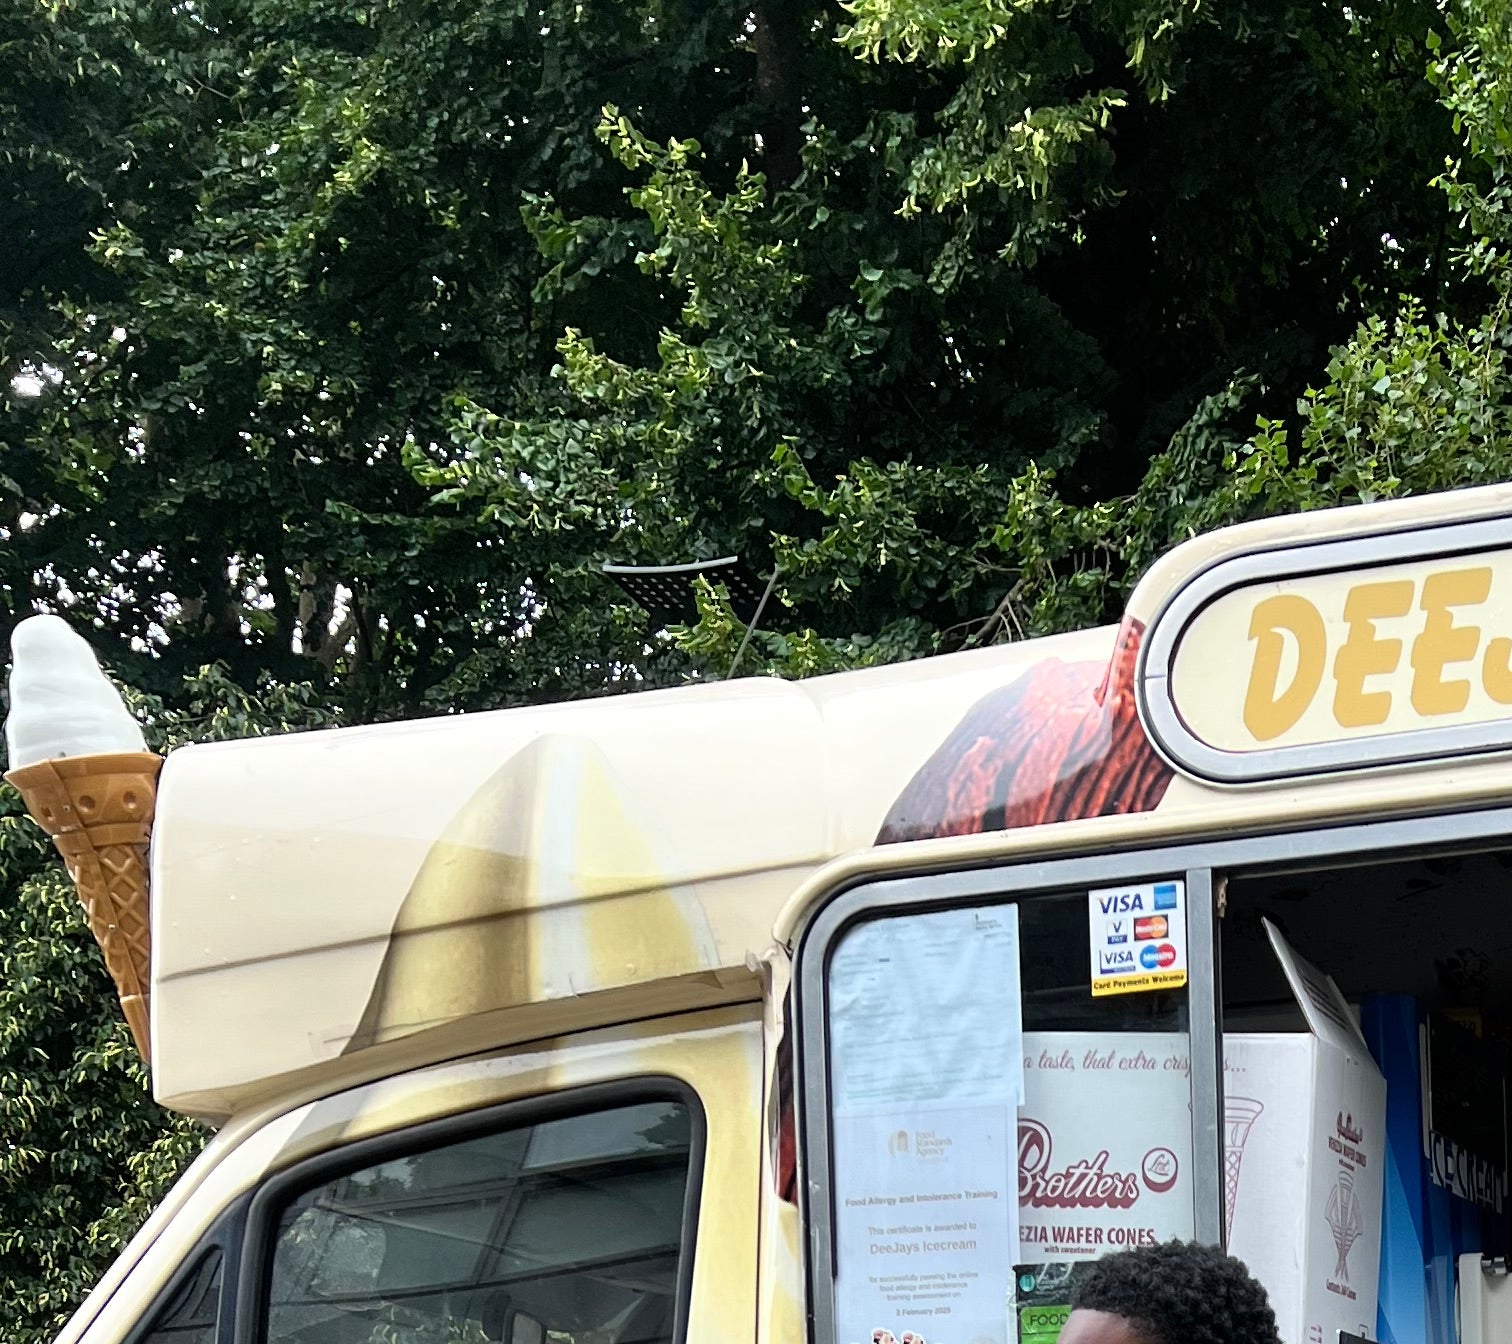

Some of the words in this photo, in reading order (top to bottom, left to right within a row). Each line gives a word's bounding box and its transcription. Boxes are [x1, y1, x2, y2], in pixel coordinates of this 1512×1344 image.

[1097, 893, 1144, 914] VISA
[1104, 950, 1134, 965] VISA
[1094, 980, 1111, 990] Card
[1113, 976, 1150, 989] Payments
[1151, 974, 1185, 984] Welcome
[1038, 1049, 1075, 1071] taste,
[1083, 1049, 1114, 1070] that
[1118, 1050, 1157, 1070] extra
[846, 1198, 867, 1207] Food
[868, 1195, 897, 1207] Allergy
[899, 1195, 915, 1204] and
[964, 1190, 998, 1200] Training
[1019, 1225, 1048, 1243] EZIA
[1052, 1226, 1103, 1244] WAFER
[1107, 1228, 1156, 1246] CONES
